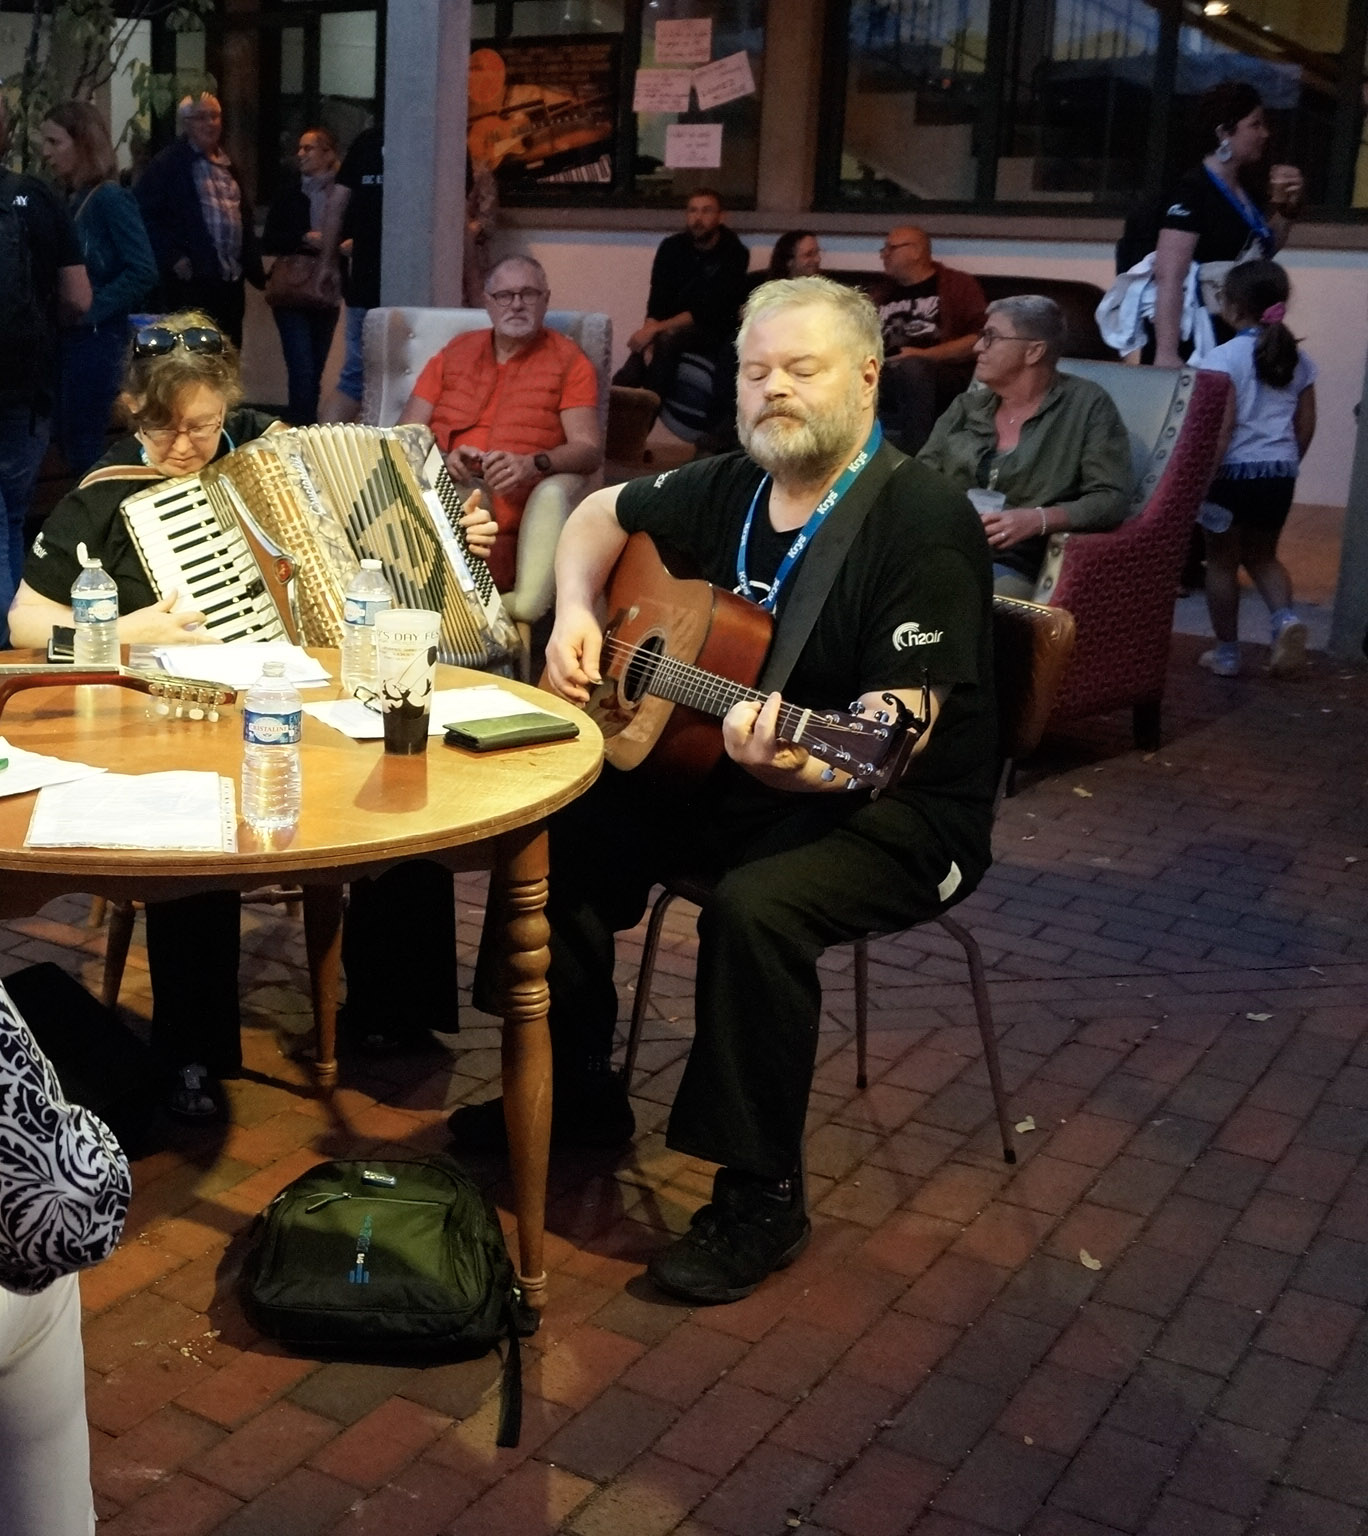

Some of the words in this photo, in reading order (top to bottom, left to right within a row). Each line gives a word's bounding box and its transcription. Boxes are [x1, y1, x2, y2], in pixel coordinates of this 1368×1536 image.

[847, 450, 868, 473] Krys
[816, 489, 839, 515] Krys
[787, 532, 807, 559] Krys
[394, 632, 418, 641] DAY
[907, 629, 944, 648] h2air
